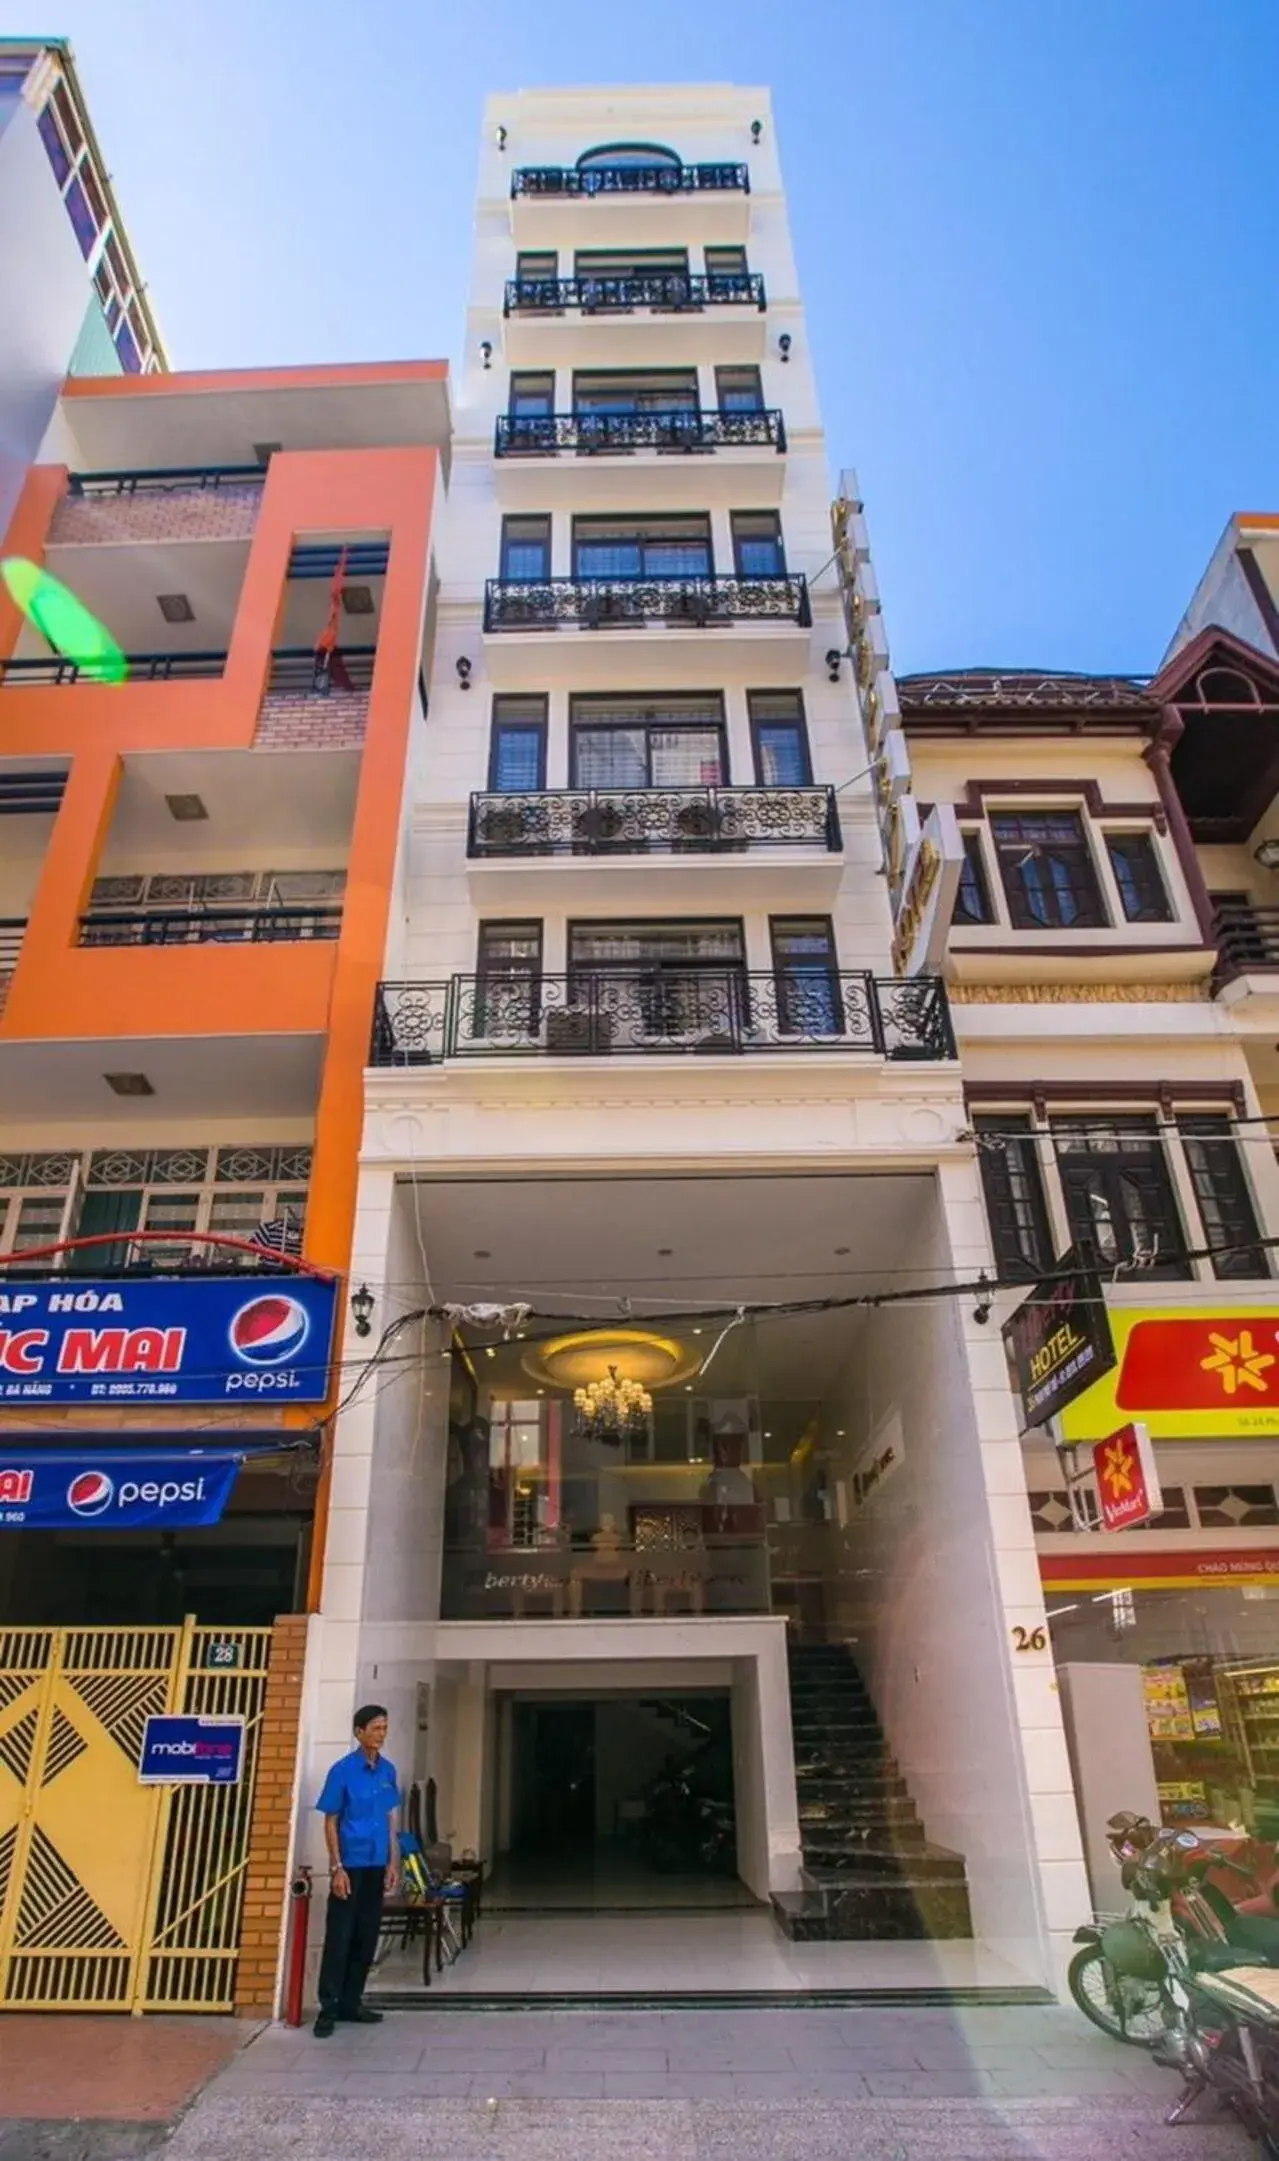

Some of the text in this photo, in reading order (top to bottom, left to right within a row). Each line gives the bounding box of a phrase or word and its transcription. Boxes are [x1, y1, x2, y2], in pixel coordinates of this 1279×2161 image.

[48, 1289, 123, 1313] HÓA
[56, 1327, 187, 1373] MAI
[1030, 1322, 1079, 1380] HOTEL
[225, 1372, 299, 1392] pepsi
[119, 1477, 204, 1507] pepsi
[1012, 1626, 1047, 1651] 26
[214, 1647, 234, 1663] 28
